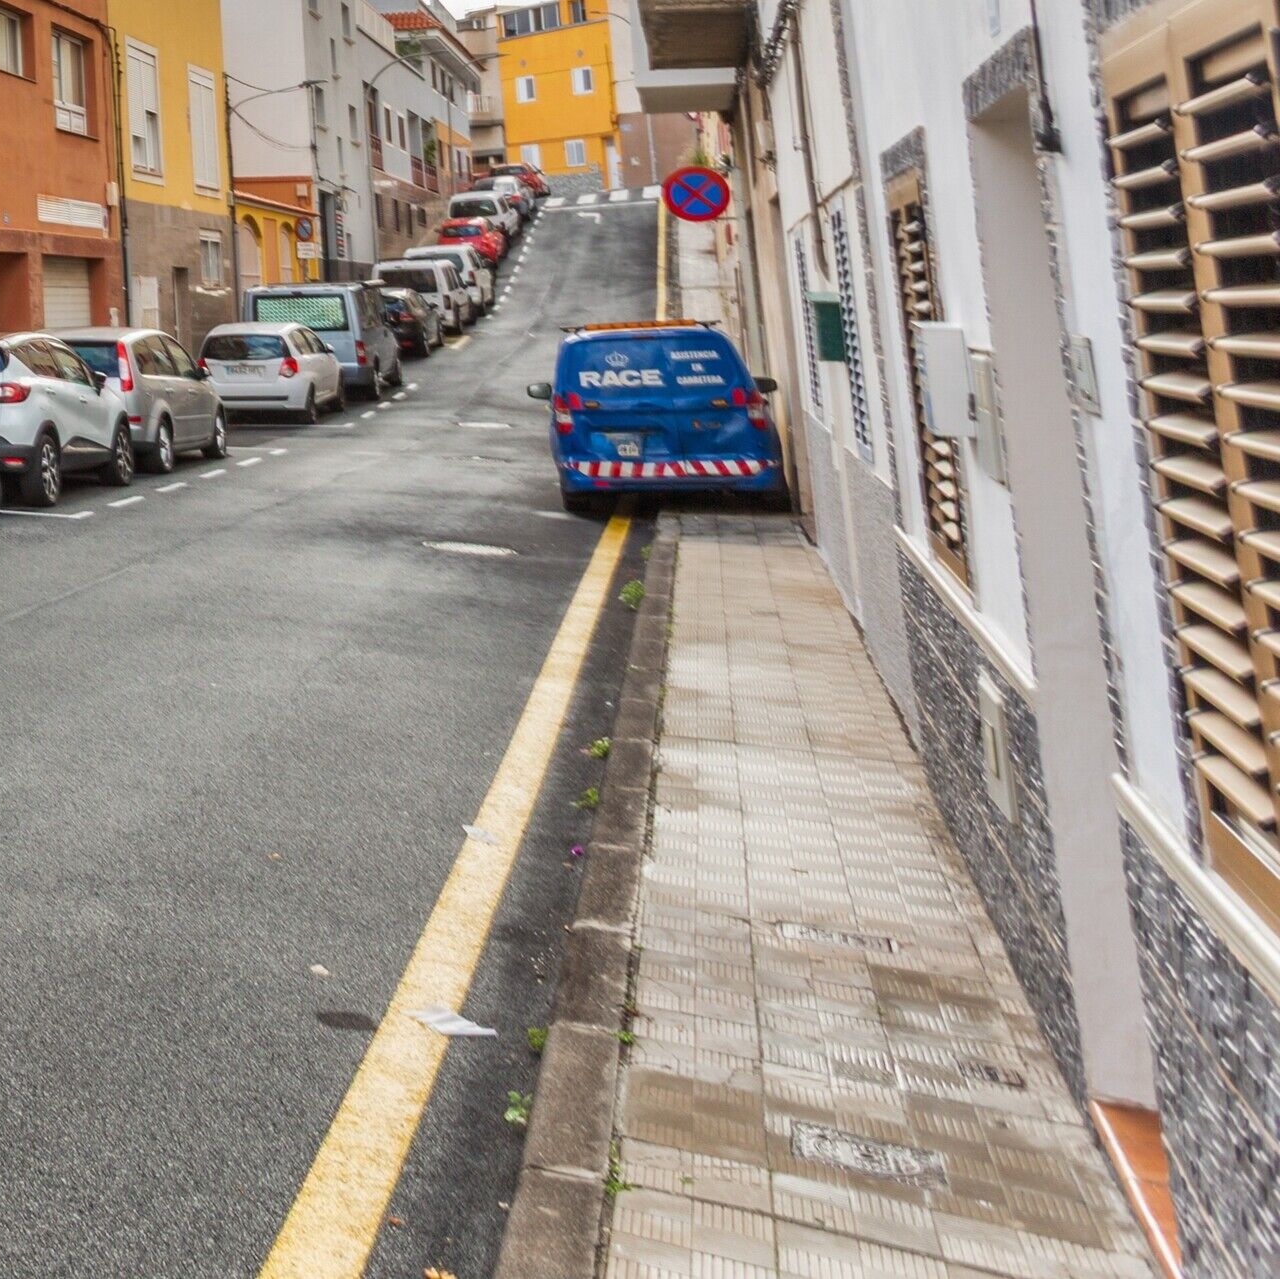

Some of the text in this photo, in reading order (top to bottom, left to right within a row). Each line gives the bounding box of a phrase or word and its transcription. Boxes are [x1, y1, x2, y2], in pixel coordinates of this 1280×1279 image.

[670, 350, 721, 360] ASISTENCIA
[578, 369, 666, 388] RACE
[676, 375, 726, 385] CARRETERA
